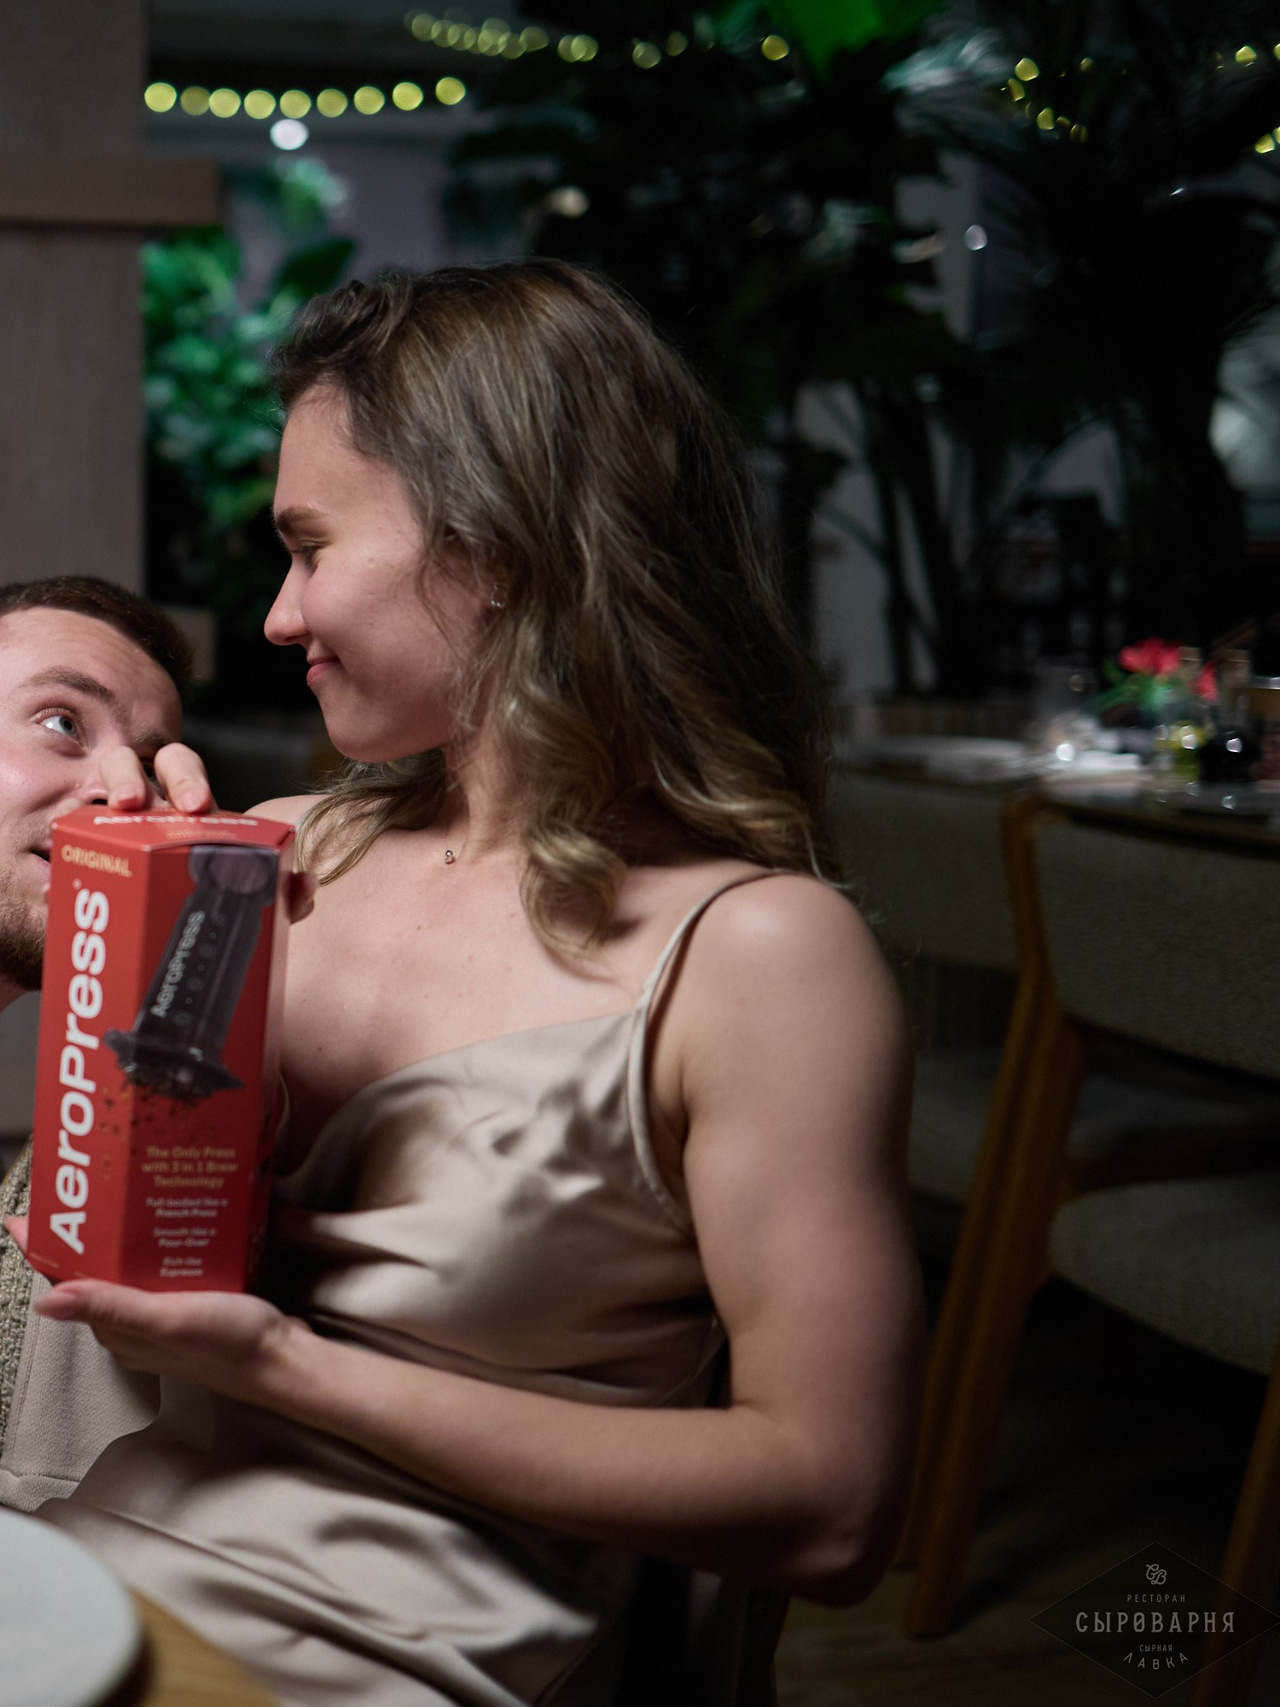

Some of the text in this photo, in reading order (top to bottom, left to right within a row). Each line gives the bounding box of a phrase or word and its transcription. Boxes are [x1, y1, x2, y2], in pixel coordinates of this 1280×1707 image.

[61, 844, 133, 878] ORIGINAL
[150, 910, 206, 1019] AeroPress
[49, 888, 110, 1255] AeroPress
[146, 1145, 236, 1161] The Only Press
[141, 1161, 169, 1173] with
[182, 1162, 194, 1173] in
[206, 1162, 238, 1173] Brew
[153, 1175, 225, 1190] Technology
[159, 1267, 205, 1279] Espresso
